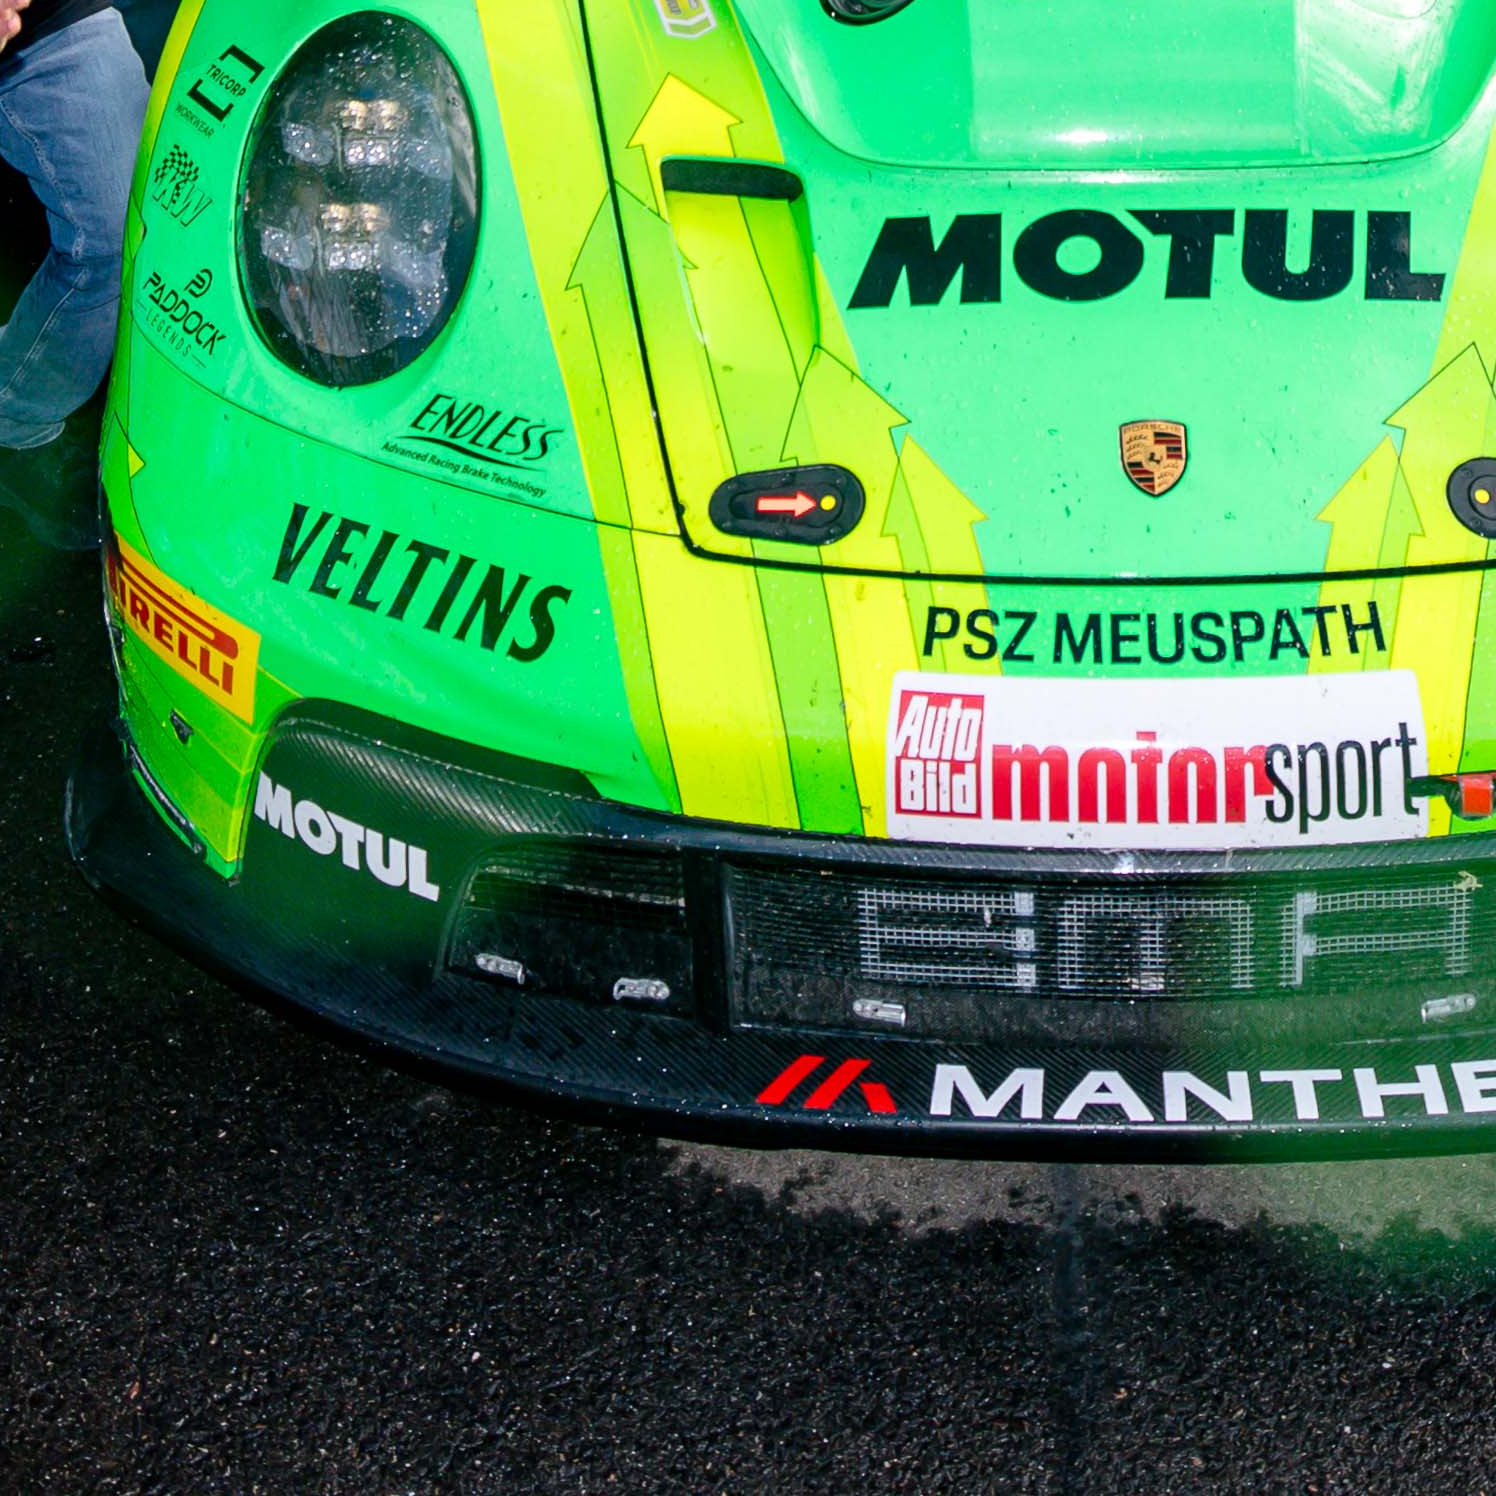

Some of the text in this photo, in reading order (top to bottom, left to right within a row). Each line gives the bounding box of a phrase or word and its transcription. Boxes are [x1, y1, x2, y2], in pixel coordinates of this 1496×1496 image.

[205, 63, 247, 98] TRICORP
[174, 103, 216, 139] WORKWEAR
[846, 207, 1446, 310] MOTUL
[142, 270, 227, 356] PADDOCK
[145, 308, 192, 356] LEGENDS
[409, 393, 565, 461] ENDLESS
[380, 441, 547, 499] Advanced Racing Brake Technology
[270, 501, 574, 664] VELTINS
[923, 601, 1388, 665] PSZ MEUSPATH
[900, 694, 980, 761] Auto
[898, 761, 978, 818] Bild
[254, 769, 440, 902] MOTUL
